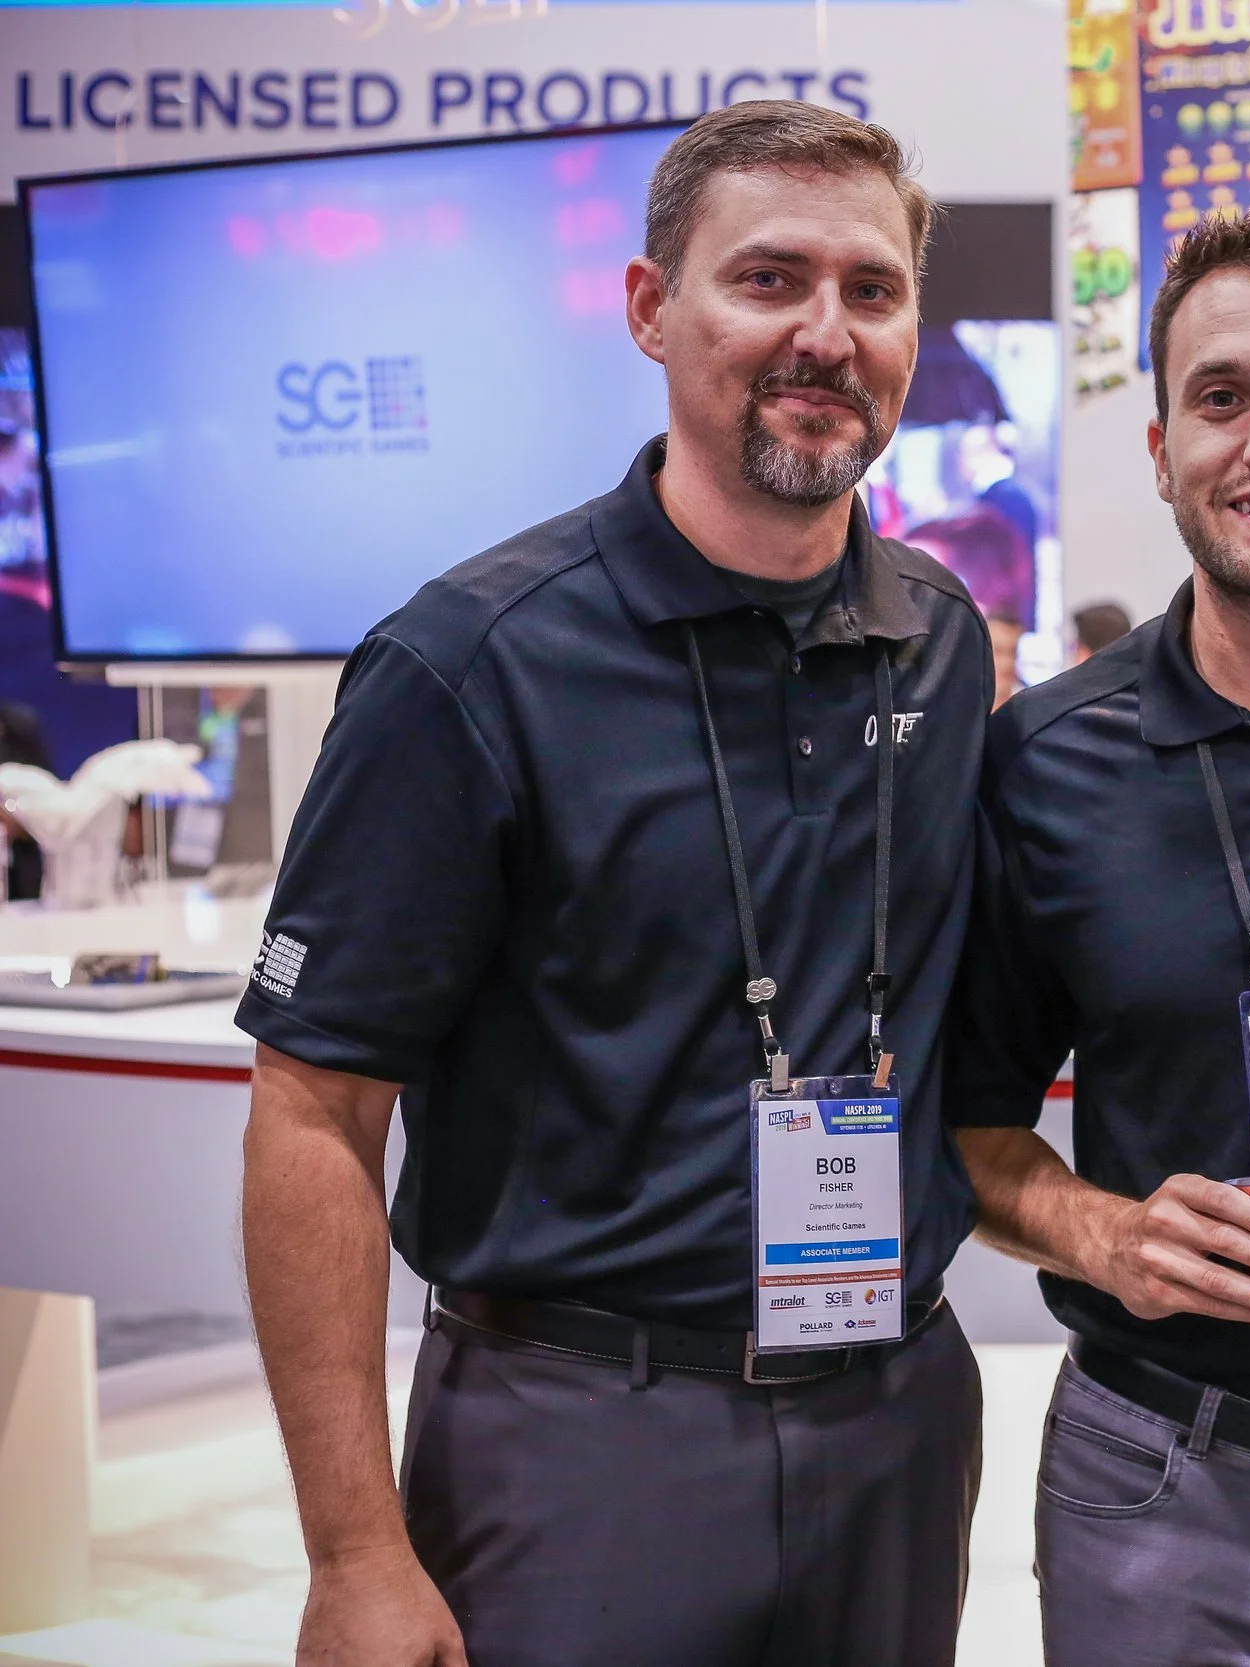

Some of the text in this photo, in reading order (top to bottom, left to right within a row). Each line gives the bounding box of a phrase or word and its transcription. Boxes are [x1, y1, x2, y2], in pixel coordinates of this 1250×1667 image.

[17, 69, 870, 133] LICENSED PRODUCTS
[276, 361, 361, 433] SG
[260, 975, 293, 998] GAMES
[845, 1105, 882, 1115] NASPL 2019
[769, 1111, 793, 1125] NASPL
[816, 1157, 856, 1175] BOB
[819, 1183, 853, 1192] FISHER
[809, 1202, 863, 1211] Director Marketing
[806, 1222, 866, 1231] Scientific Games
[801, 1246, 870, 1257] ASSOCIATE MEMBER
[770, 1295, 806, 1307] intralot
[825, 1292, 841, 1305] SG
[877, 1289, 895, 1302] IGT
[799, 1321, 833, 1330] POLLARD
